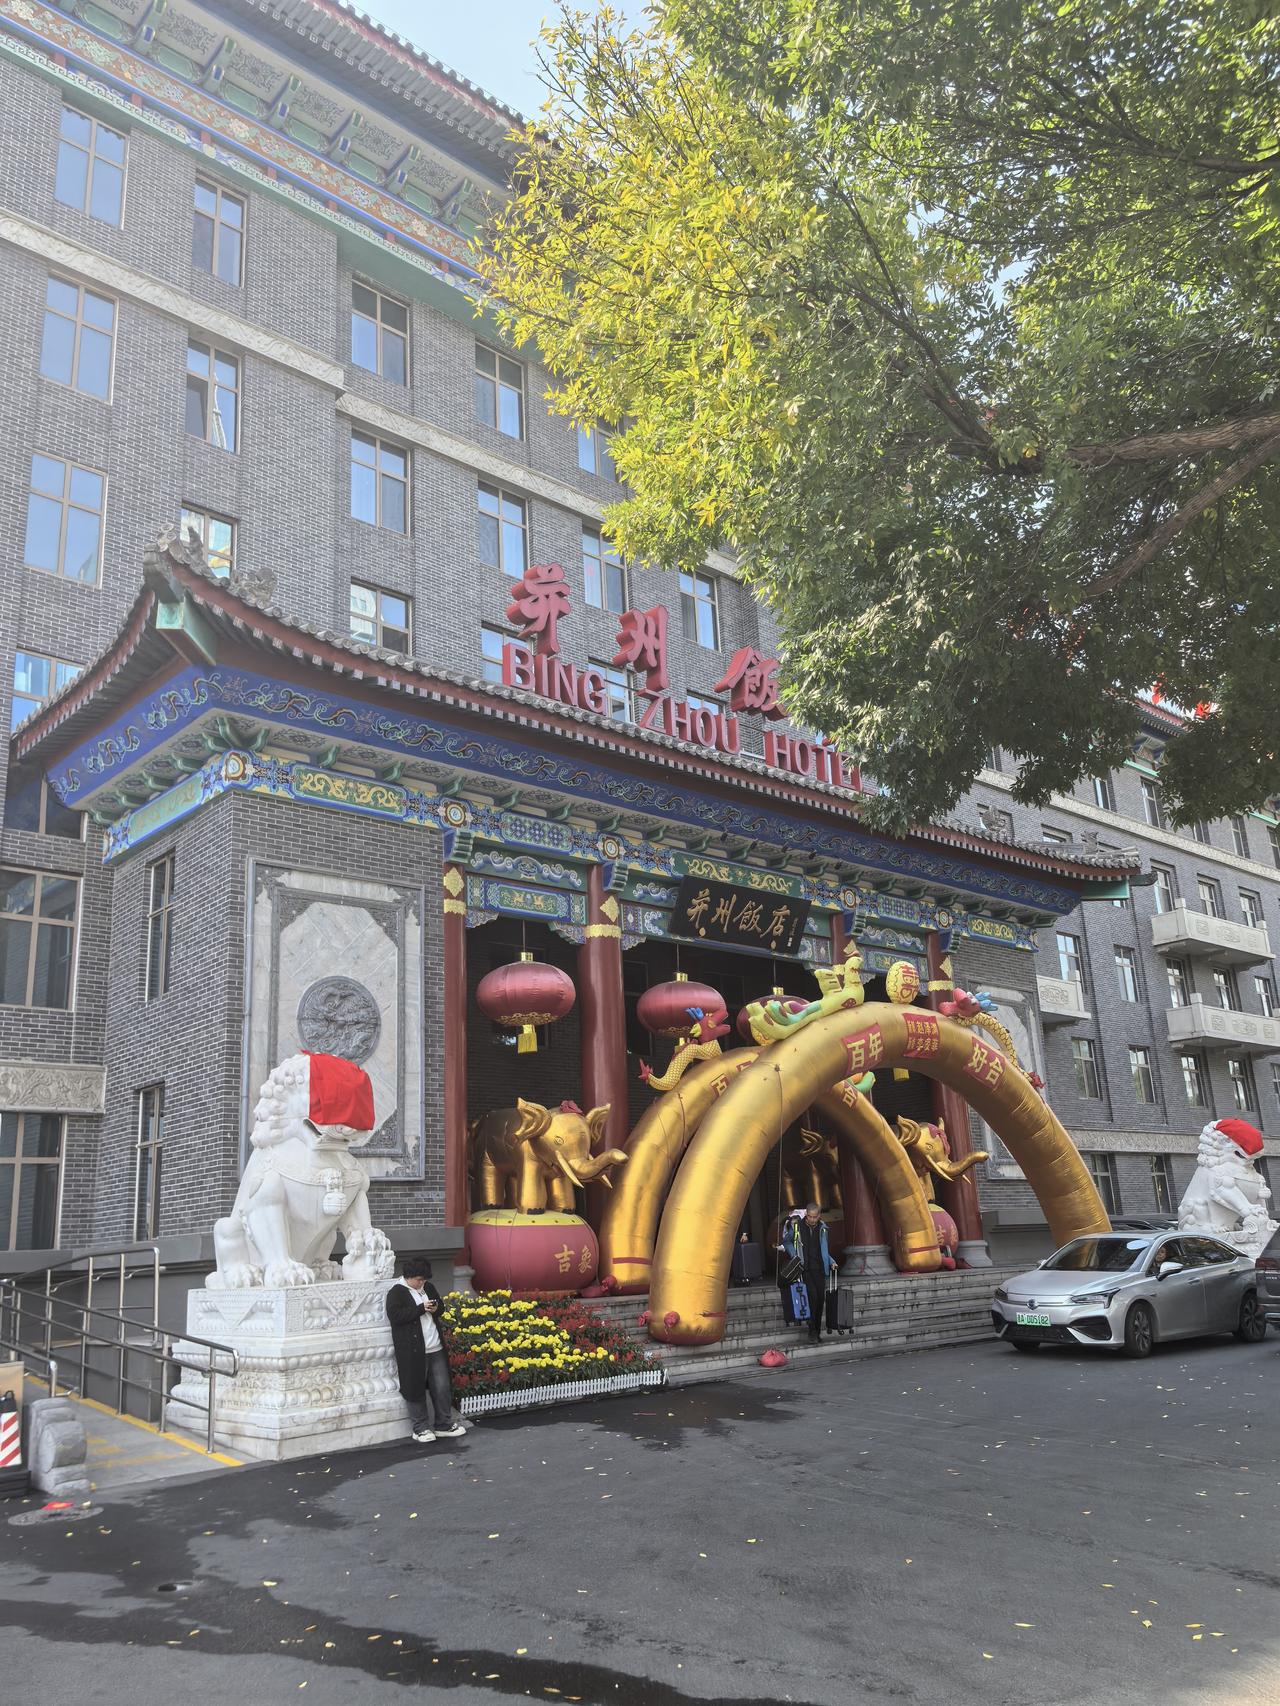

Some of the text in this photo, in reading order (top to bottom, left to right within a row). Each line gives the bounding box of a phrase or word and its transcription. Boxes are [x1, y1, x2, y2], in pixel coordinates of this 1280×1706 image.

[502, 643, 607, 716] BING
[637, 689, 741, 755] ZHOU
[846, 1031, 884, 1071] 百年
[967, 1042, 1003, 1086] 好合
[554, 1244, 593, 1274] 吉象
